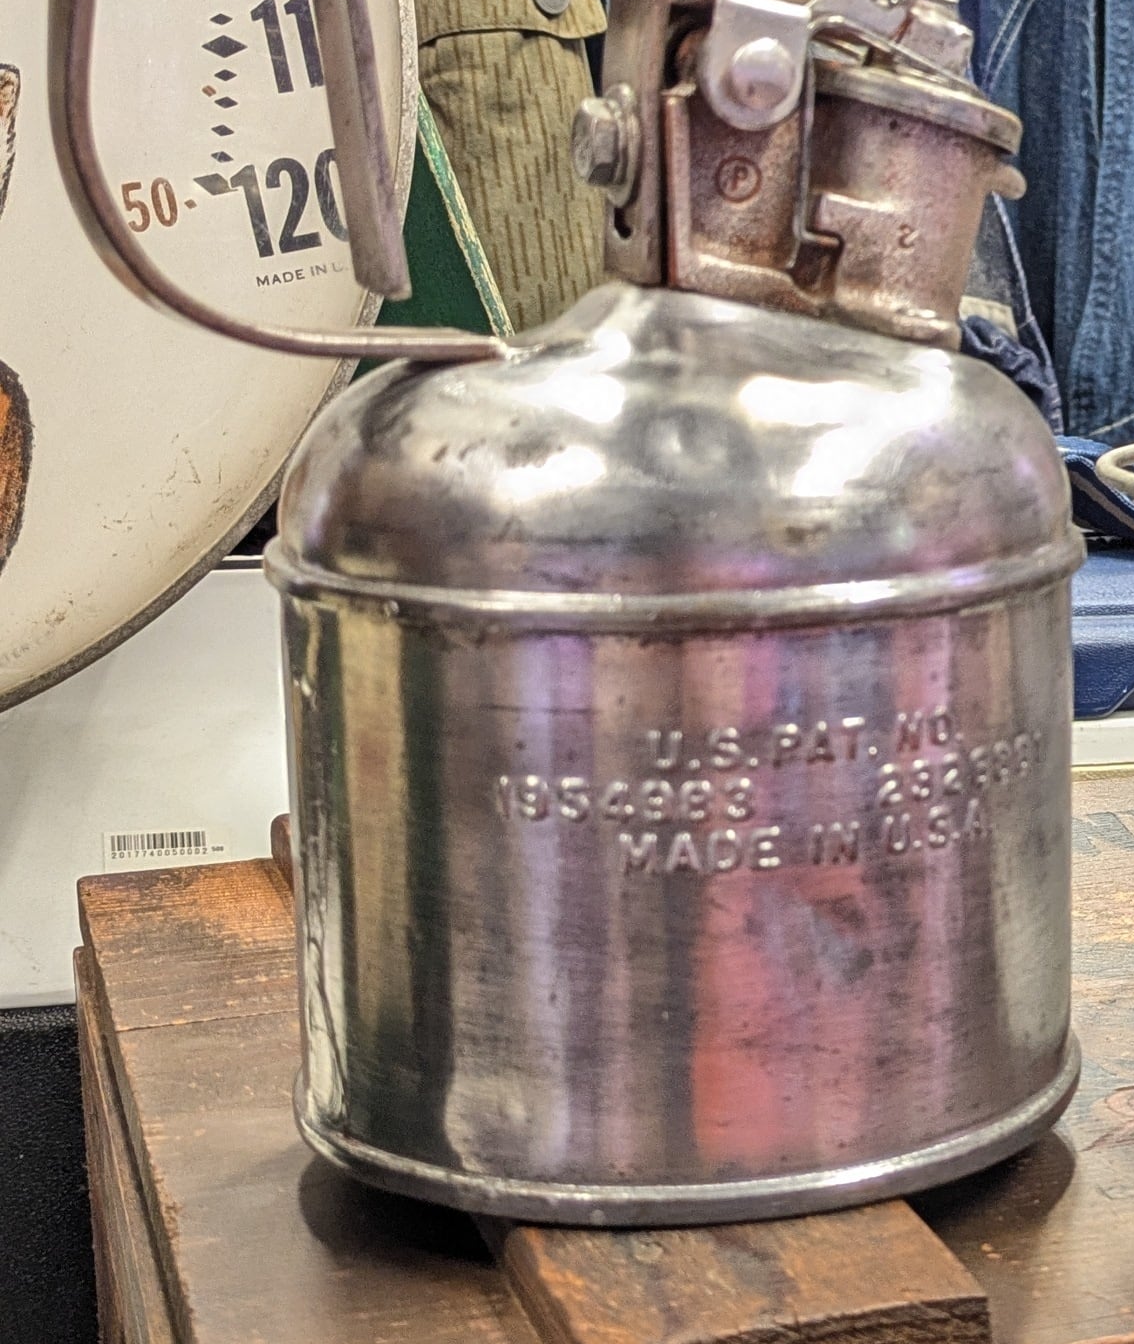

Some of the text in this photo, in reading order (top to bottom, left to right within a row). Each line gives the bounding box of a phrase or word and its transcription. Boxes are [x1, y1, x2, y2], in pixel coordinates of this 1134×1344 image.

[122, 176, 178, 233] 50
[256, 268, 306, 288] MADE
[310, 264, 328, 277] IN
[617, 825, 781, 876] MADE
[811, 820, 860, 866] IN
